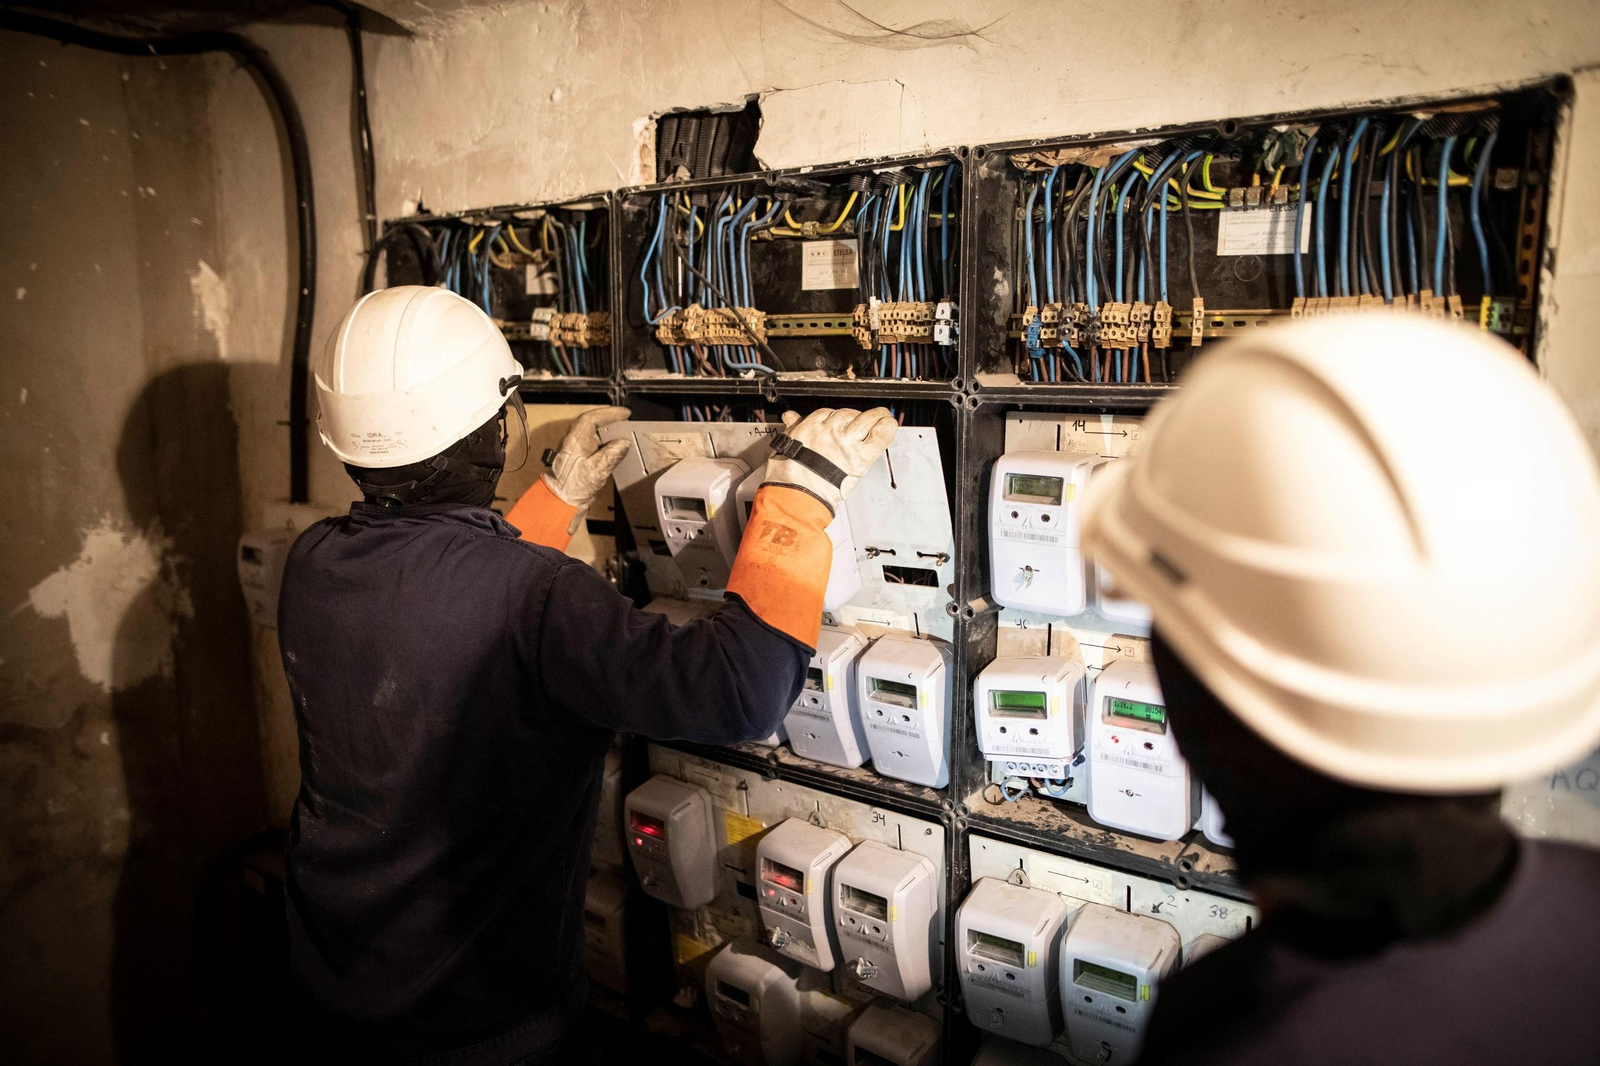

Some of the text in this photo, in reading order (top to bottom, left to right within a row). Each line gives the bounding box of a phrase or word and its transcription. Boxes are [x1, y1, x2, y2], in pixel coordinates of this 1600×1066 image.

[1072, 419, 1086, 432] 14
[871, 811, 886, 826] 34
[1167, 895, 1177, 908] 2
[1208, 904, 1228, 919] 38
